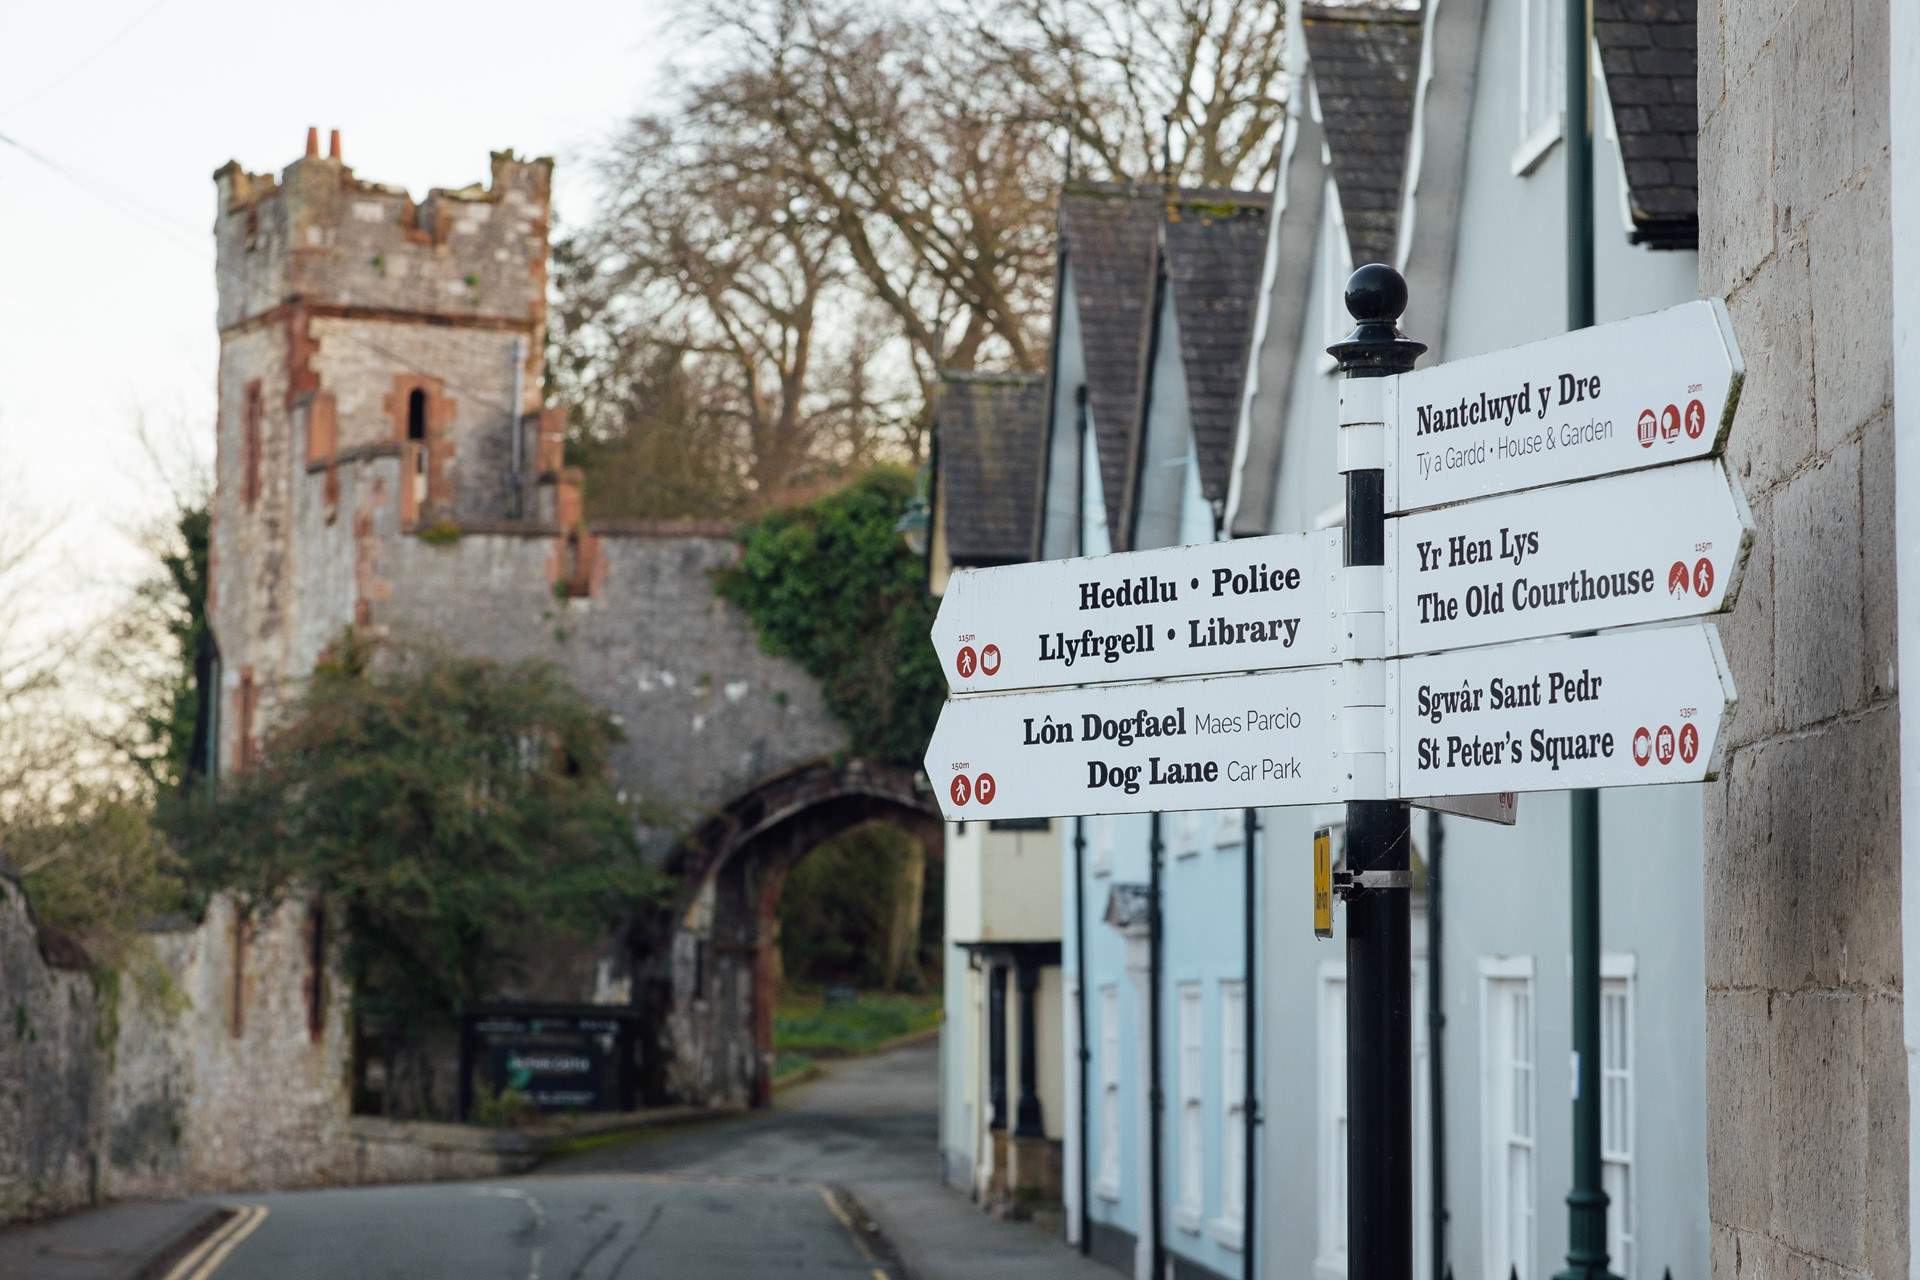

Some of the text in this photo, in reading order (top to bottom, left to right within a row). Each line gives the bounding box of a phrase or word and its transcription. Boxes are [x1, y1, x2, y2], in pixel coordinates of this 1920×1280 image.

[1416, 373, 1601, 437] Nantclwyd y Dre
[1416, 417, 1613, 481] Tŷ a Gardd House & Garden
[1416, 527, 1539, 573] Yr Hen Lys
[1078, 562, 1301, 611] Heddlu Police
[1417, 568, 1655, 624] The Old Courthouse
[958, 634, 976, 642] 115m
[1038, 616, 1301, 668] Llyfrgell Library
[1417, 668, 1603, 725] Sgwâr Sant Pedr
[1022, 706, 1302, 748] Lôn Dogfael Maes Parcio
[1417, 728, 1614, 771] St Peter’s Square
[951, 762, 970, 771] 150m
[980, 779, 991, 800] P
[1086, 756, 1302, 795] Dog Lane Car Park
